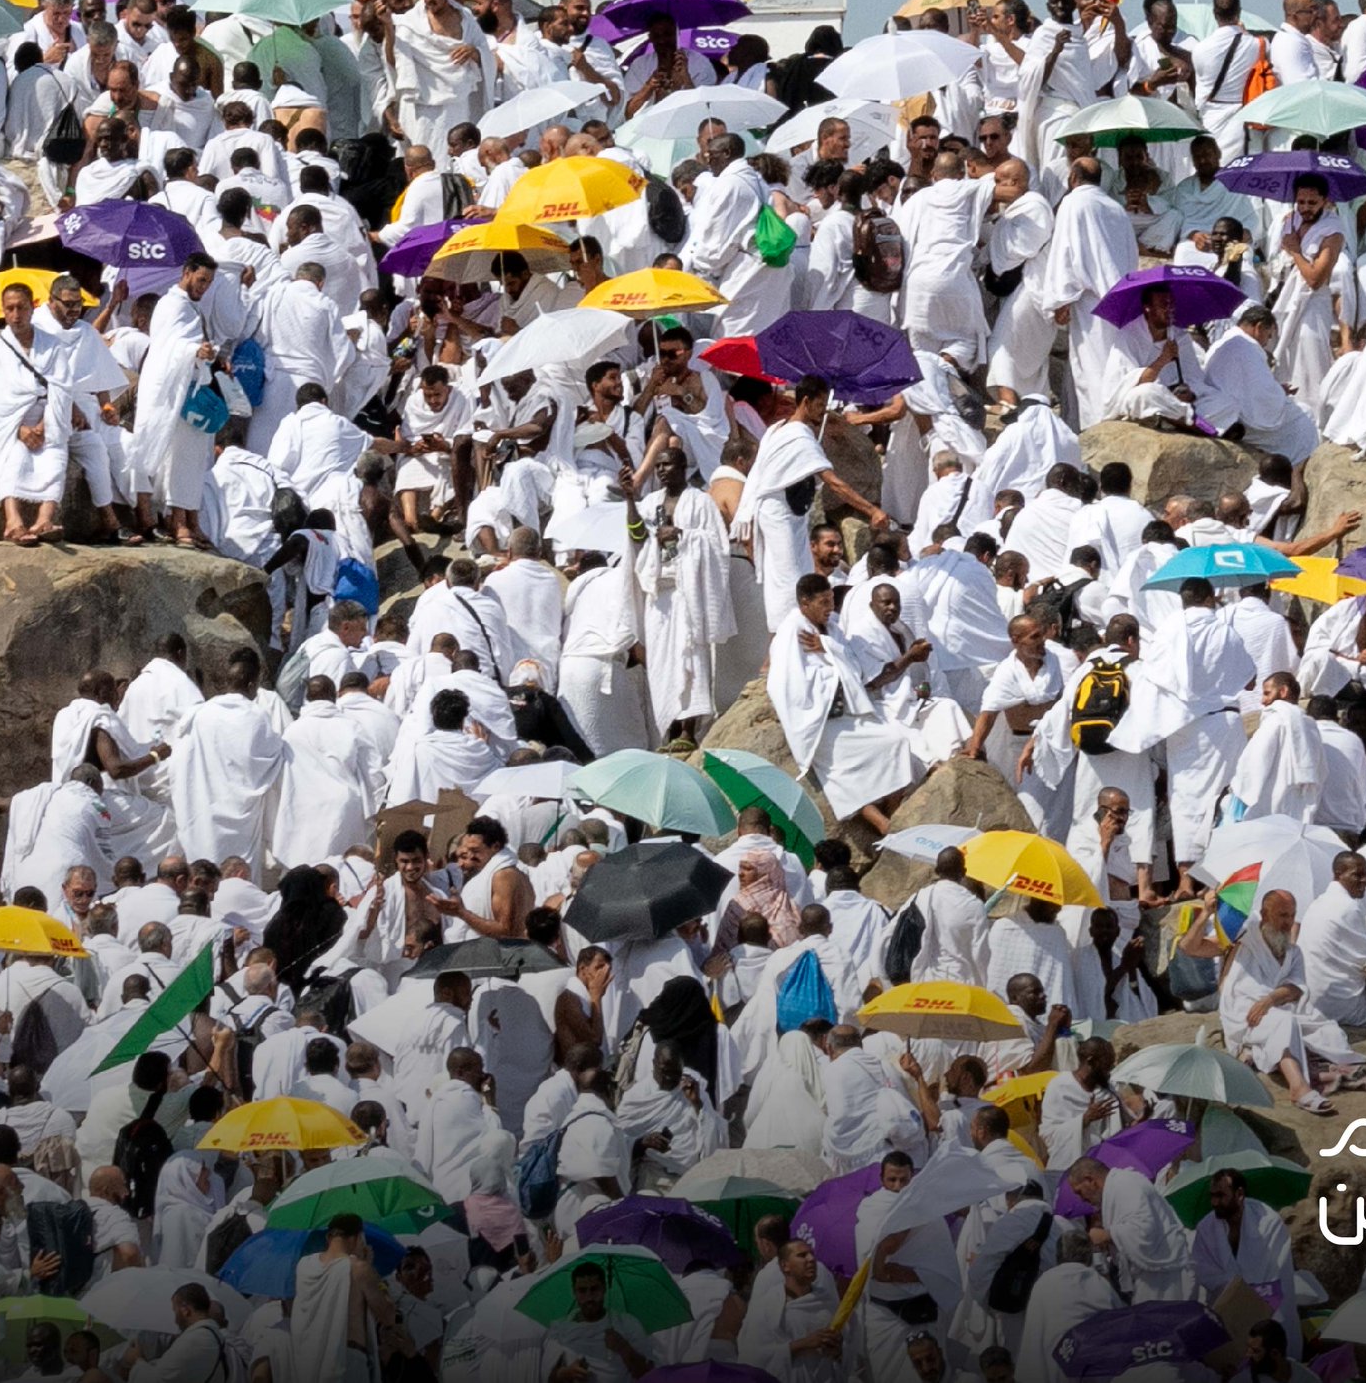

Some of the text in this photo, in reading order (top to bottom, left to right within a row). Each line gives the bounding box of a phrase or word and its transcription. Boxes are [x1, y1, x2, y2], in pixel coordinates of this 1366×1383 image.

[694, 34, 730, 49] stc
[1316, 154, 1352, 170] stc
[542, 201, 580, 219] DHL
[63, 212, 83, 235] stc
[127, 239, 167, 260] stc
[1170, 266, 1208, 278] stc
[610, 292, 649, 306] DHL
[1014, 874, 1056, 897] DHL
[912, 996, 958, 1011] DHL
[248, 1131, 293, 1147] DHL
[1131, 1340, 1175, 1363] stc
